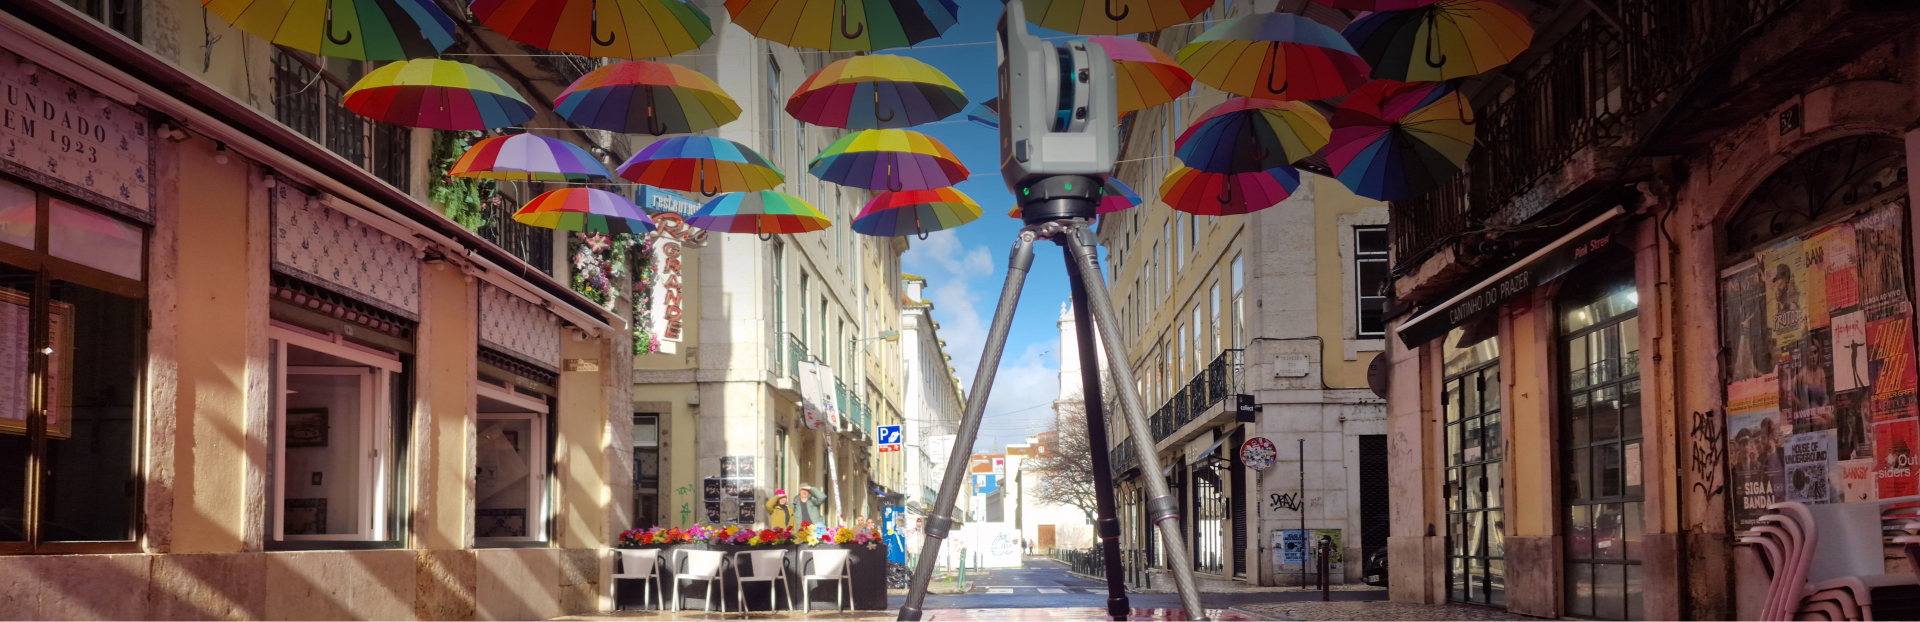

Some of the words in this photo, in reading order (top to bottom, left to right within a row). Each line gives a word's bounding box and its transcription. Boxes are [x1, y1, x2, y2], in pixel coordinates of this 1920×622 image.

[3, 108, 36, 138] EM
[50, 129, 97, 163] 1923
[1574, 242, 1588, 260] Pink
[1590, 232, 1611, 251] Street
[662, 242, 683, 339] GRANDE
[1449, 295, 1483, 324] CANTINHO
[1485, 287, 1497, 307] DO
[1500, 271, 1529, 299] PRAZER
[1870, 391, 1897, 402] SINISTER
[1898, 388, 1915, 397] GRIFT
[880, 427, 889, 441] P
[1792, 442, 1810, 454] HOUSE
[1811, 441, 1818, 451] OF
[1785, 451, 1827, 464] UNDERGROUND
[1898, 453, 1918, 466] Out
[1843, 466, 1868, 480] BANKSY
[1878, 467, 1911, 478] siders
[1744, 481, 1765, 496] SIGA
[1766, 480, 1773, 494] A
